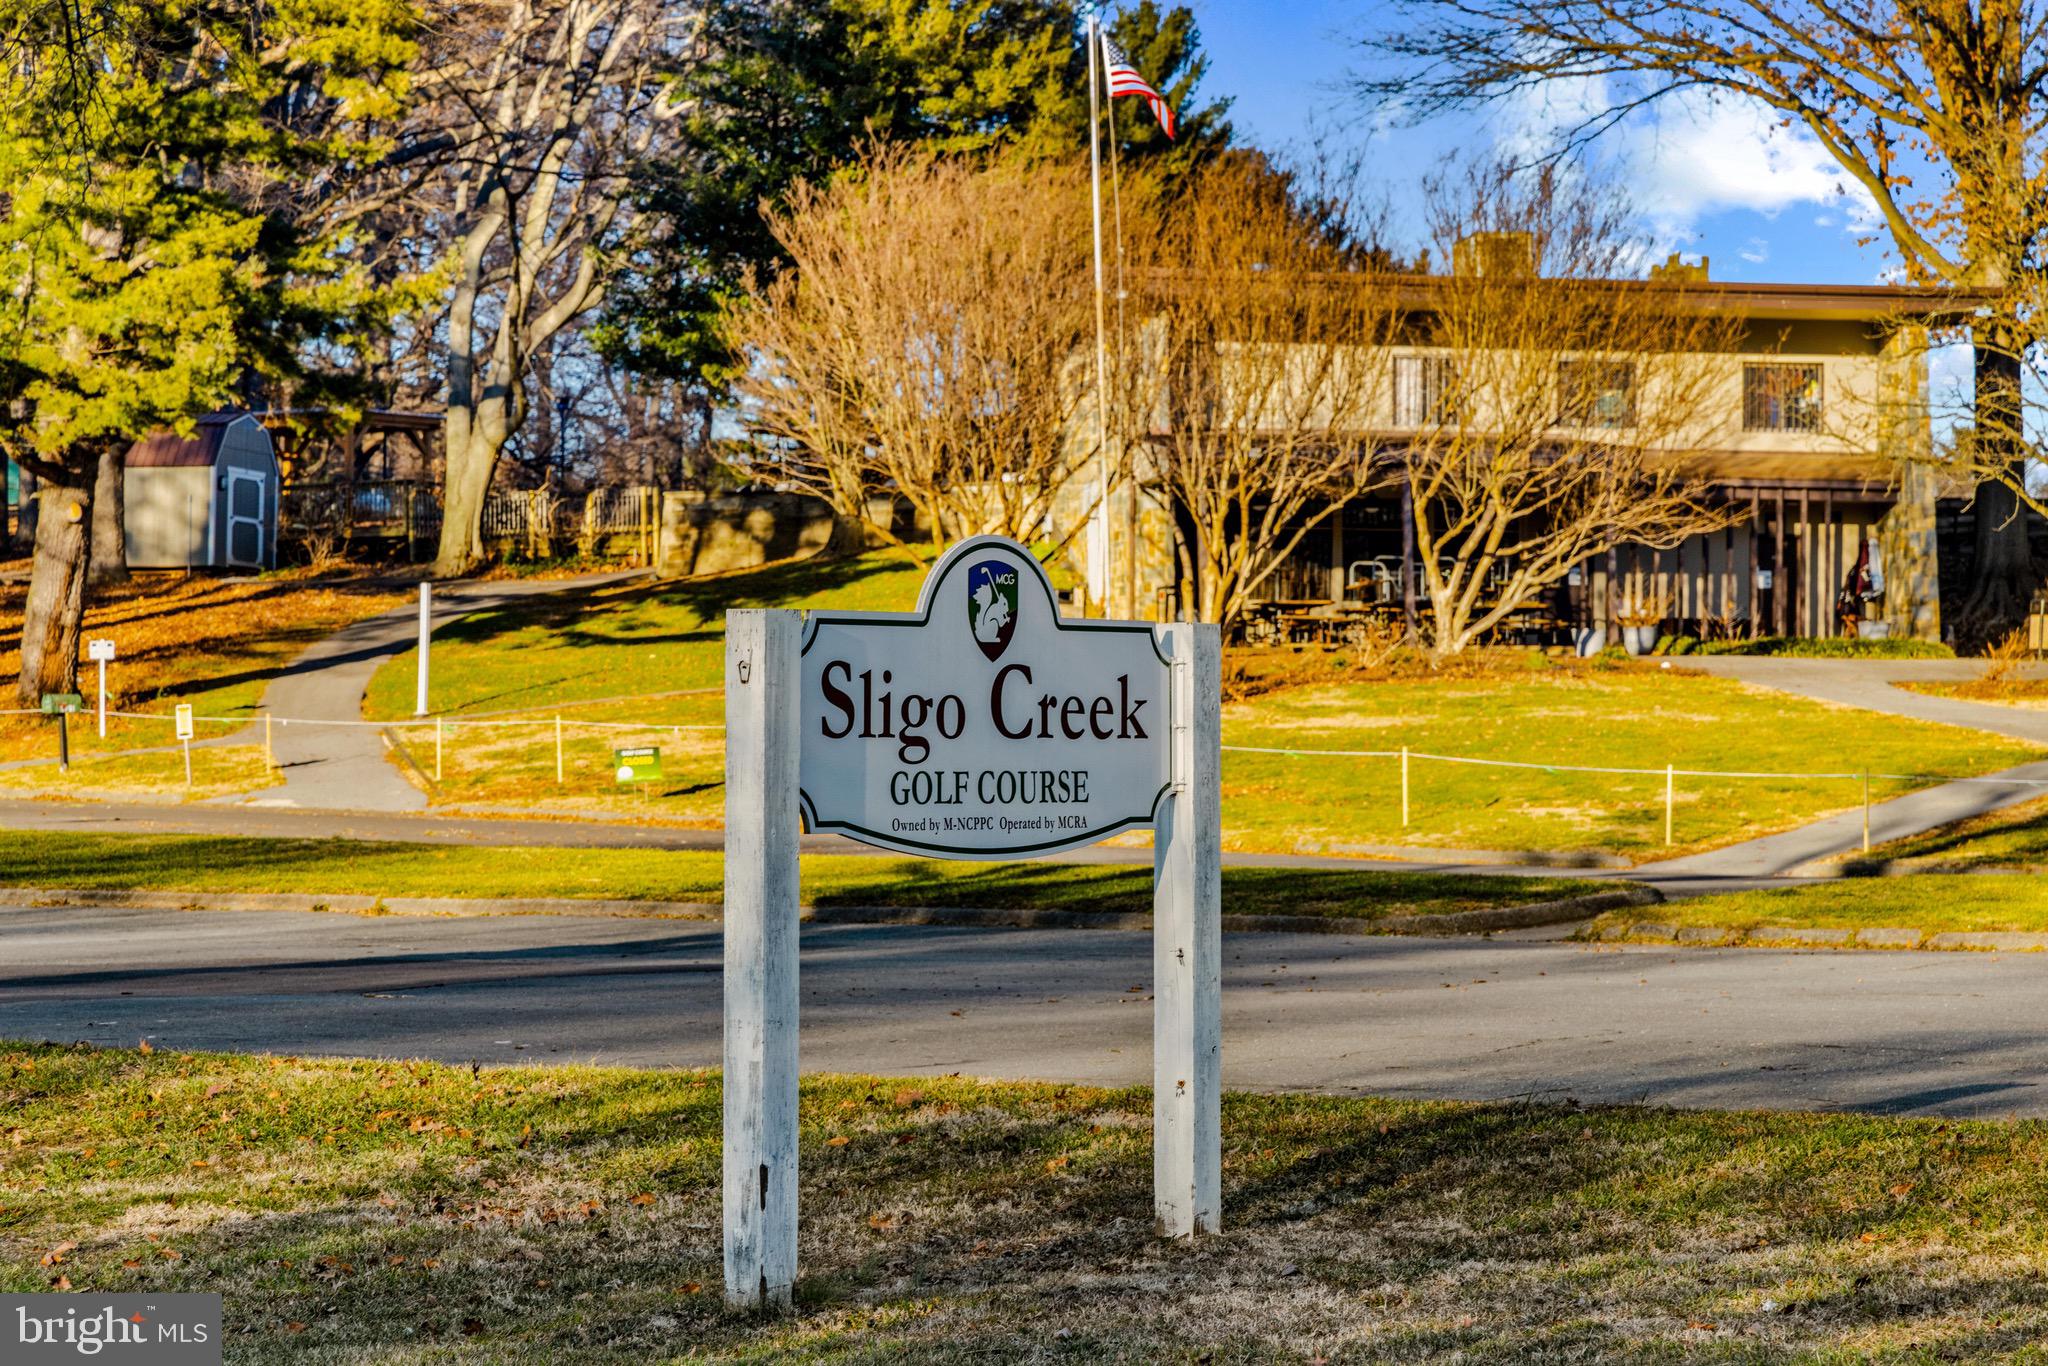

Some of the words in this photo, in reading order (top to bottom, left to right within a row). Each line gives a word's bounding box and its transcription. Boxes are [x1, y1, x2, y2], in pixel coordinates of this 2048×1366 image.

[995, 573, 1015, 585] MCG
[821, 660, 966, 765] Sligo
[990, 663, 1149, 739] Creek
[890, 770, 969, 805] GOLF
[977, 770, 1089, 804] COURSE
[892, 818, 926, 831] Owned
[928, 818, 940, 835] by
[943, 816, 994, 831] M-NCPPC
[999, 816, 1041, 833] Operated
[1044, 816, 1055, 833] by
[1057, 815, 1088, 829] MCRA
